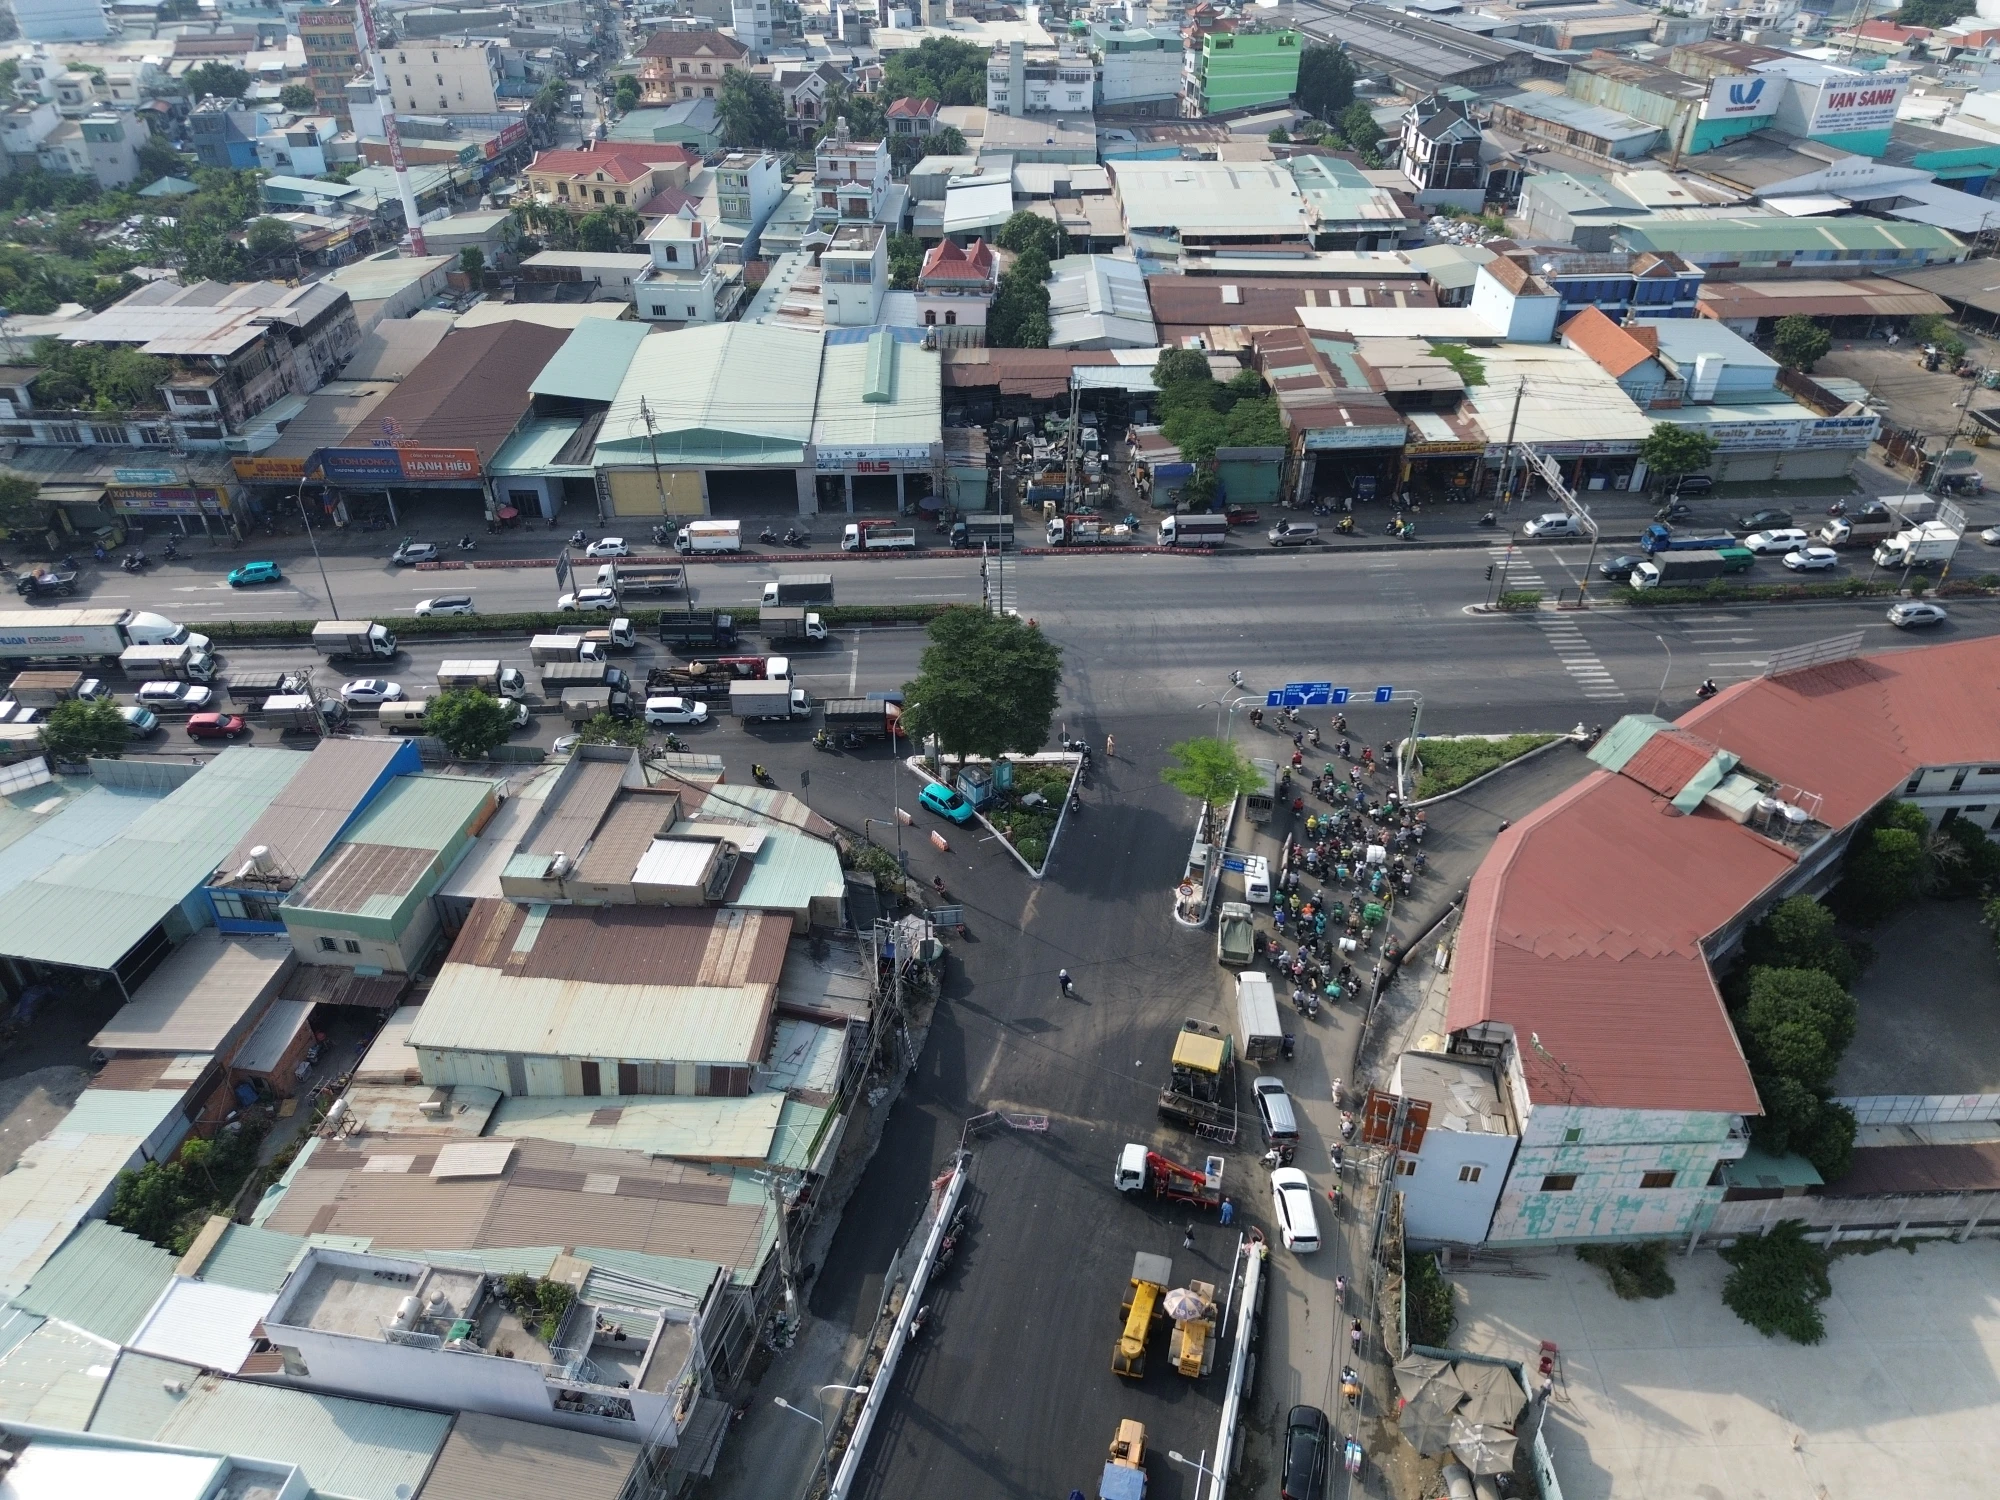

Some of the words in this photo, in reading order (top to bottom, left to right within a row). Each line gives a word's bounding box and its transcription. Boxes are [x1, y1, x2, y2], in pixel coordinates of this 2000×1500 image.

[1829, 92, 1857, 111] VẠN
[1858, 89, 1897, 107] SANH
[1713, 428, 1749, 438] Healthy
[1753, 427, 1788, 437] Beauty
[407, 461, 443, 473] HẠNH
